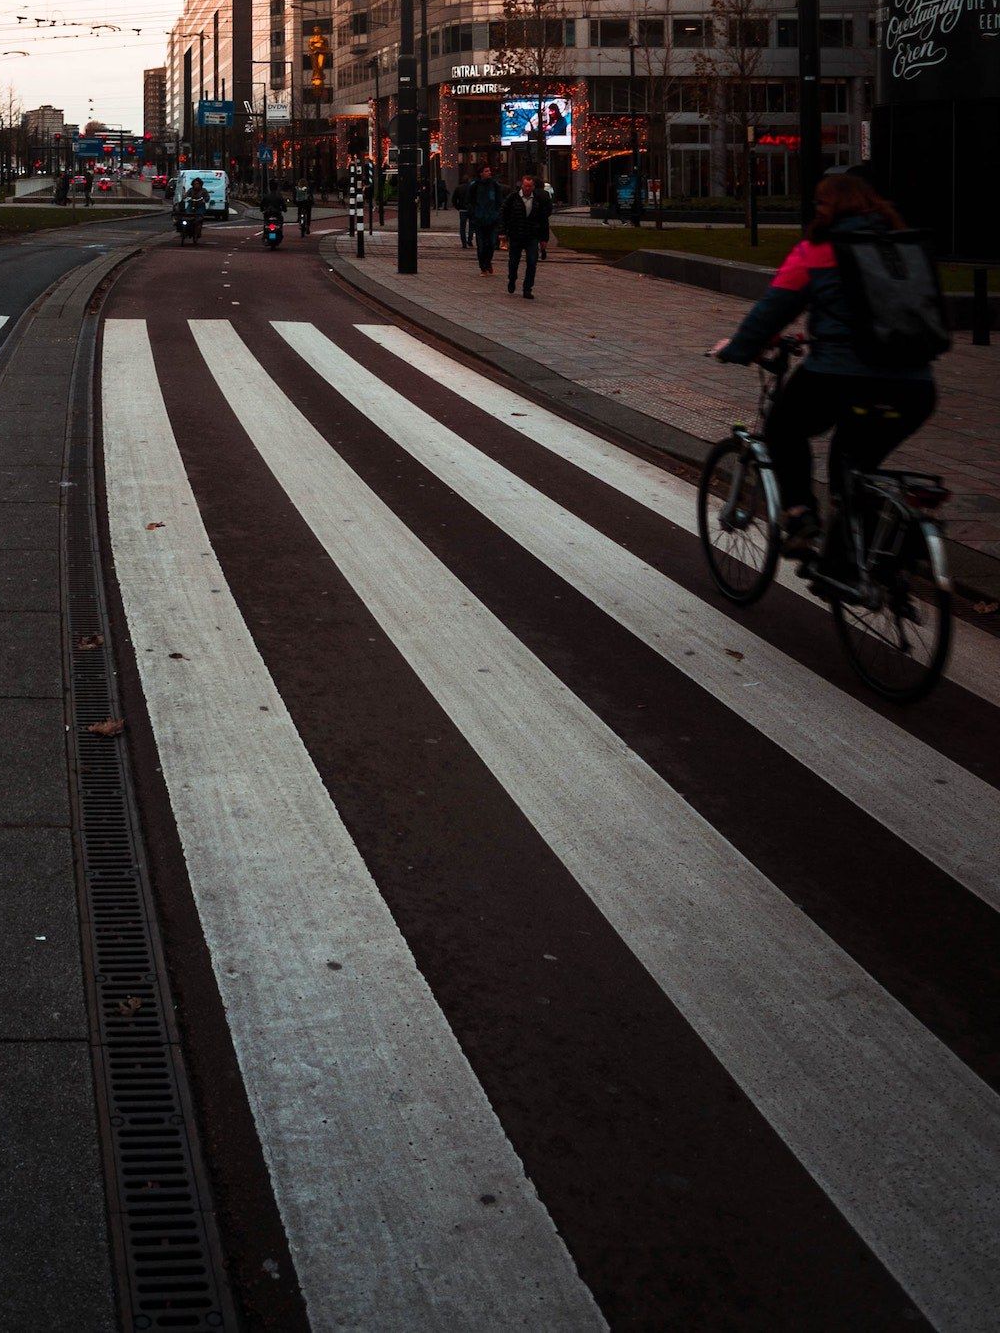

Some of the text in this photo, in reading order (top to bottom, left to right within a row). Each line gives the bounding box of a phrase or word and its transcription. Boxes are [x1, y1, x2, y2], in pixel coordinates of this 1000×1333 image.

[893, 41, 947, 80] Eren
[452, 65, 480, 78] CENTRAL
[457, 83, 498, 94] CITY CENTRE
